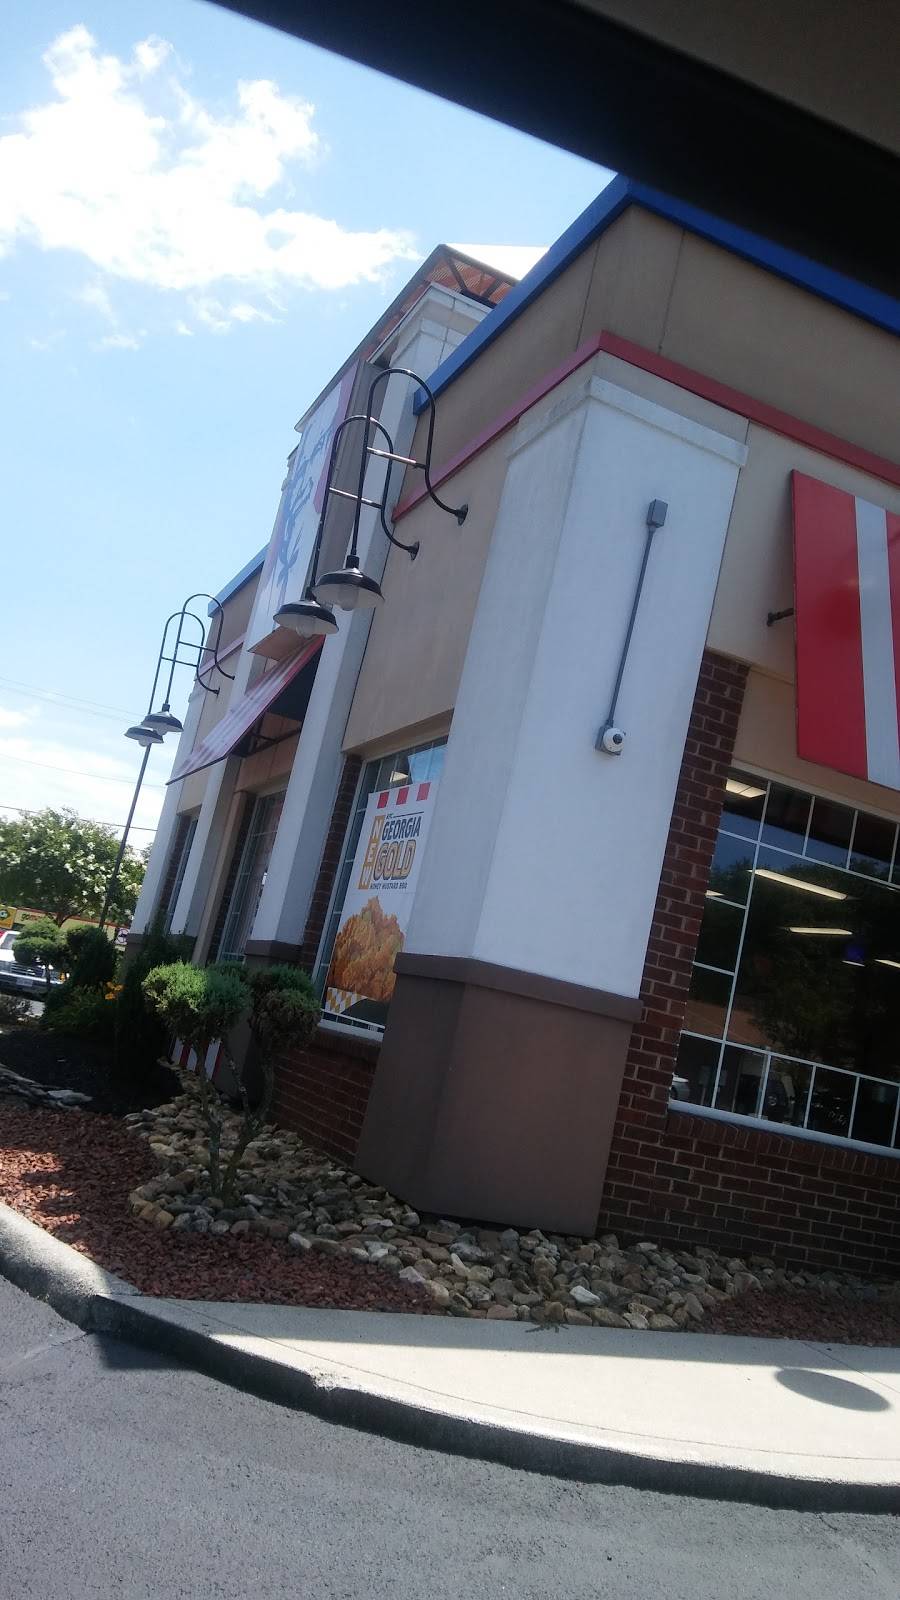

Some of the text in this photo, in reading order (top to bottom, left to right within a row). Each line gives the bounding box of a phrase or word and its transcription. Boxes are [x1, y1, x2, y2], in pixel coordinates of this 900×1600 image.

[381, 816, 422, 841] GEORGIA
[360, 819, 382, 886] NEW
[373, 839, 417, 881] GOLD
